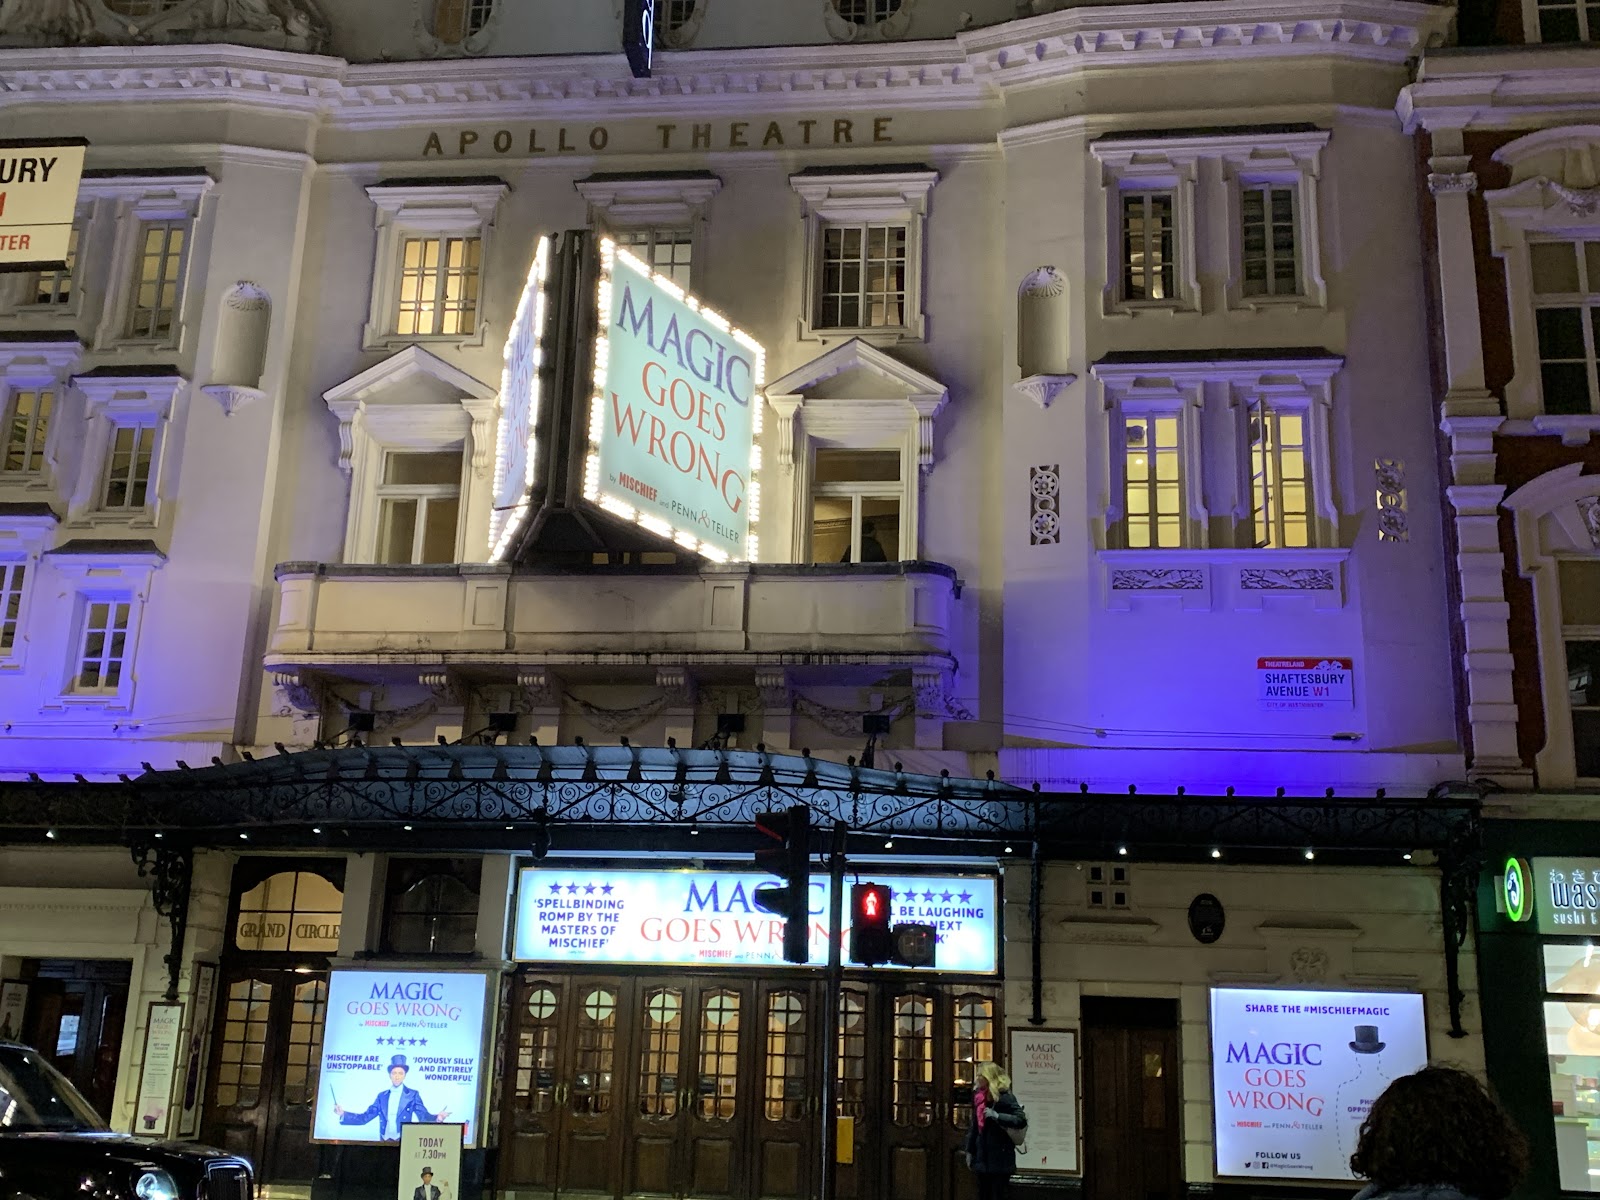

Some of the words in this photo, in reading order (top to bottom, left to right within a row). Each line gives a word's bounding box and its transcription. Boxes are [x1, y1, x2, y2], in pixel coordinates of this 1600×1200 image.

[423, 127, 609, 156] APOLLO
[656, 117, 893, 149] THEATRE
[615, 280, 751, 408] MAGIC
[642, 361, 727, 441] GOES
[610, 390, 745, 514] WRONG
[609, 473, 617, 484] by
[619, 471, 658, 503] MISCHIEF
[659, 500, 670, 510] and
[671, 499, 698, 524] PENN
[711, 518, 740, 544] TELLER
[1264, 673, 1345, 685] SHAFTESBURY
[1266, 685, 1309, 697] AVENUE
[1312, 686, 1330, 697] W1
[683, 879, 825, 915] MAGC
[538, 911, 575, 922] ROMP
[578, 912, 594, 923] BY
[596, 912, 620, 923] THE
[899, 906, 915, 916] BE
[919, 907, 985, 919] LAUGHING
[1553, 911, 1586, 925] sushi
[240, 922, 286, 938] GRAND
[295, 923, 340, 939] CIRCLE
[541, 924, 597, 935] MASTERS
[600, 925, 616, 936] OF
[640, 917, 722, 943] GOES
[930, 920, 963, 931] NEXT
[699, 949, 732, 959] MISCHIEF
[369, 981, 444, 1001] MAGIC
[346, 1001, 389, 1016] GOES
[395, 1001, 462, 1021] WRONG
[1245, 1004, 1279, 1013] SHARE
[1281, 1005, 1301, 1014] THE
[1303, 1006, 1390, 1016] #MISCHIEFMAGIC
[364, 1020, 390, 1028] MISCHIEF
[1025, 1043, 1062, 1054] MAGIC
[1225, 1041, 1323, 1066] MAGIC
[453, 1057, 474, 1065] SILLY
[418, 1065, 435, 1073] AND
[437, 1065, 473, 1074] ENTIRELY
[1244, 1068, 1306, 1088] GOES
[1227, 1090, 1325, 1117] WRONG
[418, 1137, 444, 1148] TODAY
[422, 1149, 447, 1160] 7.30PM
[1255, 1151, 1288, 1160] FOLLOW
[1290, 1152, 1302, 1160] US
